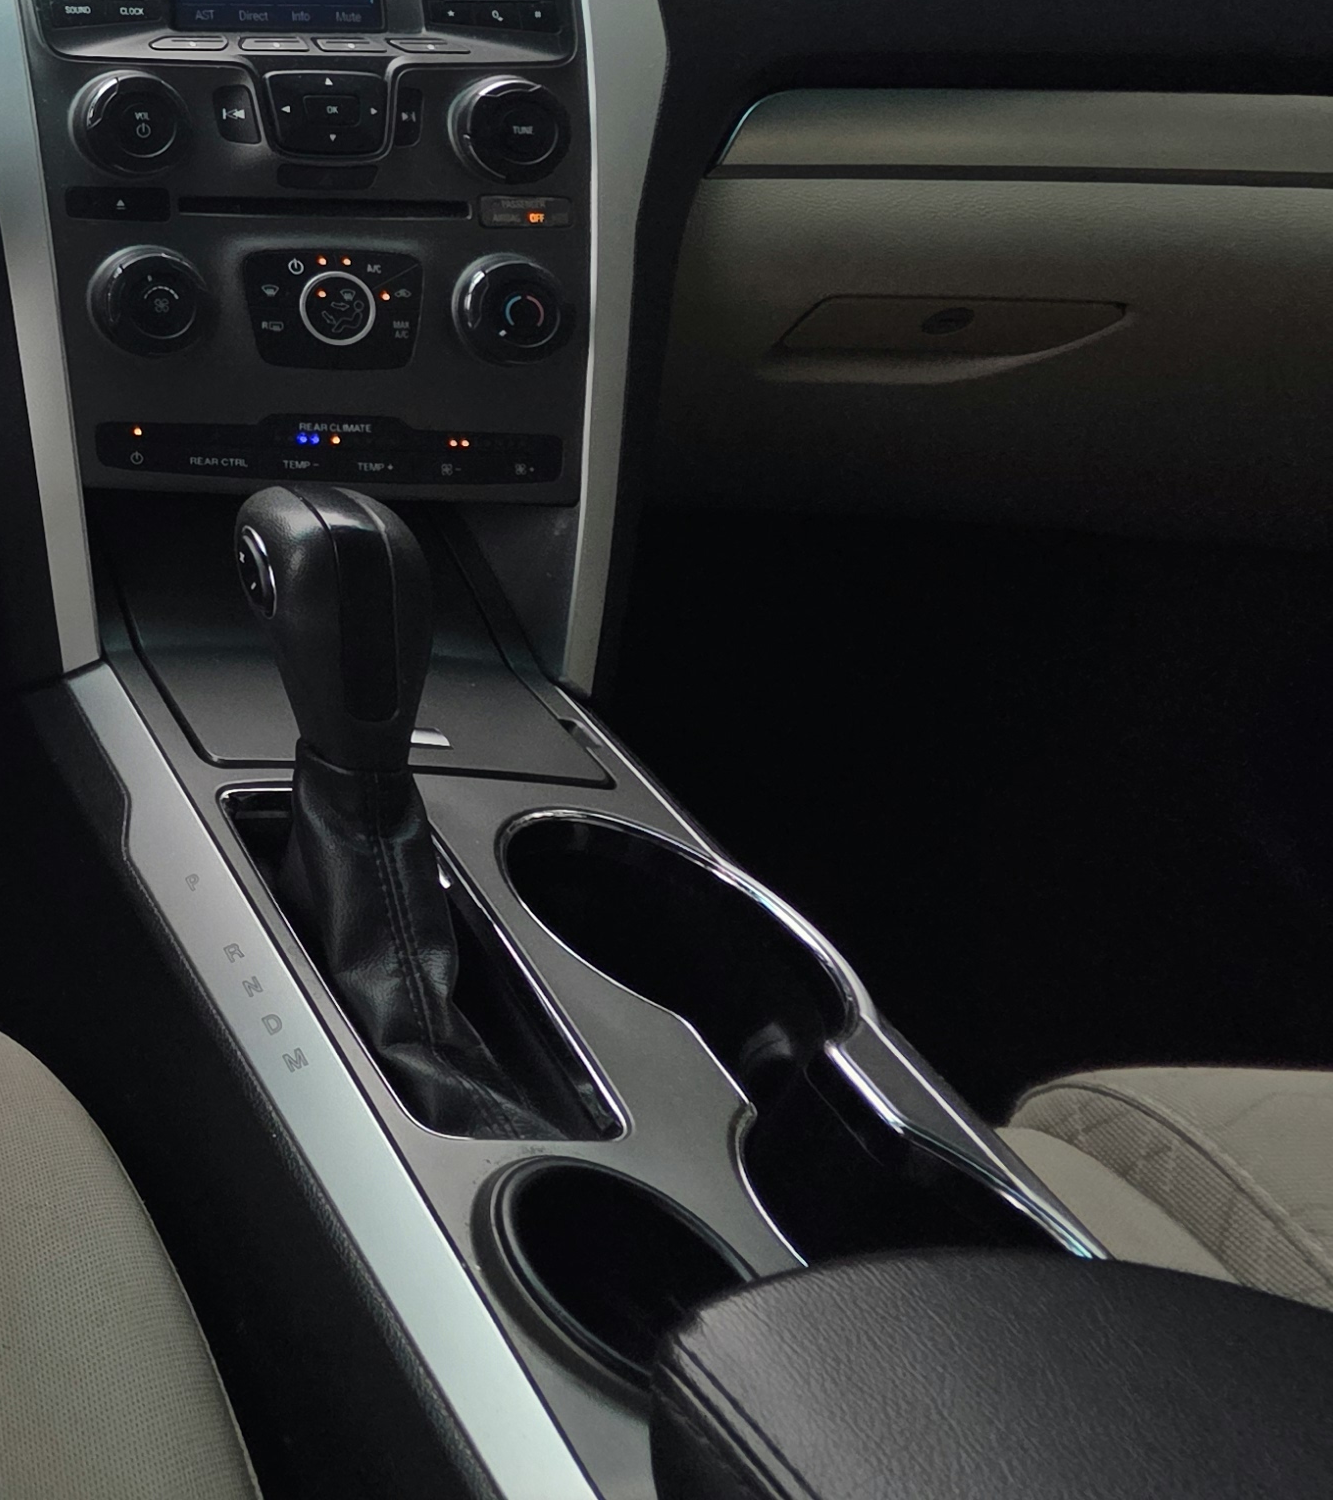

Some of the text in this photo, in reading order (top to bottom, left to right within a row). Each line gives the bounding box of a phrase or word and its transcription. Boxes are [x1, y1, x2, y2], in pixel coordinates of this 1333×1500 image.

[64, 5, 92, 15] SOUND
[119, 7, 145, 16] CLOCK
[195, 9, 216, 20] AST
[238, 10, 269, 21] Direct
[291, 10, 311, 21] Info
[335, 11, 362, 22] Mute
[325, 105, 340, 115] OK
[134, 111, 151, 120] VOL
[512, 125, 534, 135] TUNE
[529, 213, 545, 223] OFF
[366, 264, 382, 274] A/C
[392, 321, 410, 330] MAX
[394, 330, 409, 340] A/C
[299, 423, 372, 433] REAR CLIMATE
[189, 456, 248, 467] REAR CTRL
[282, 460, 311, 470] TEMP
[357, 462, 386, 472] TEMP
[185, 873, 200, 892] P
[223, 942, 245, 964] R
[242, 975, 264, 998] N
[261, 1013, 283, 1036] D
[281, 1047, 310, 1073] M
